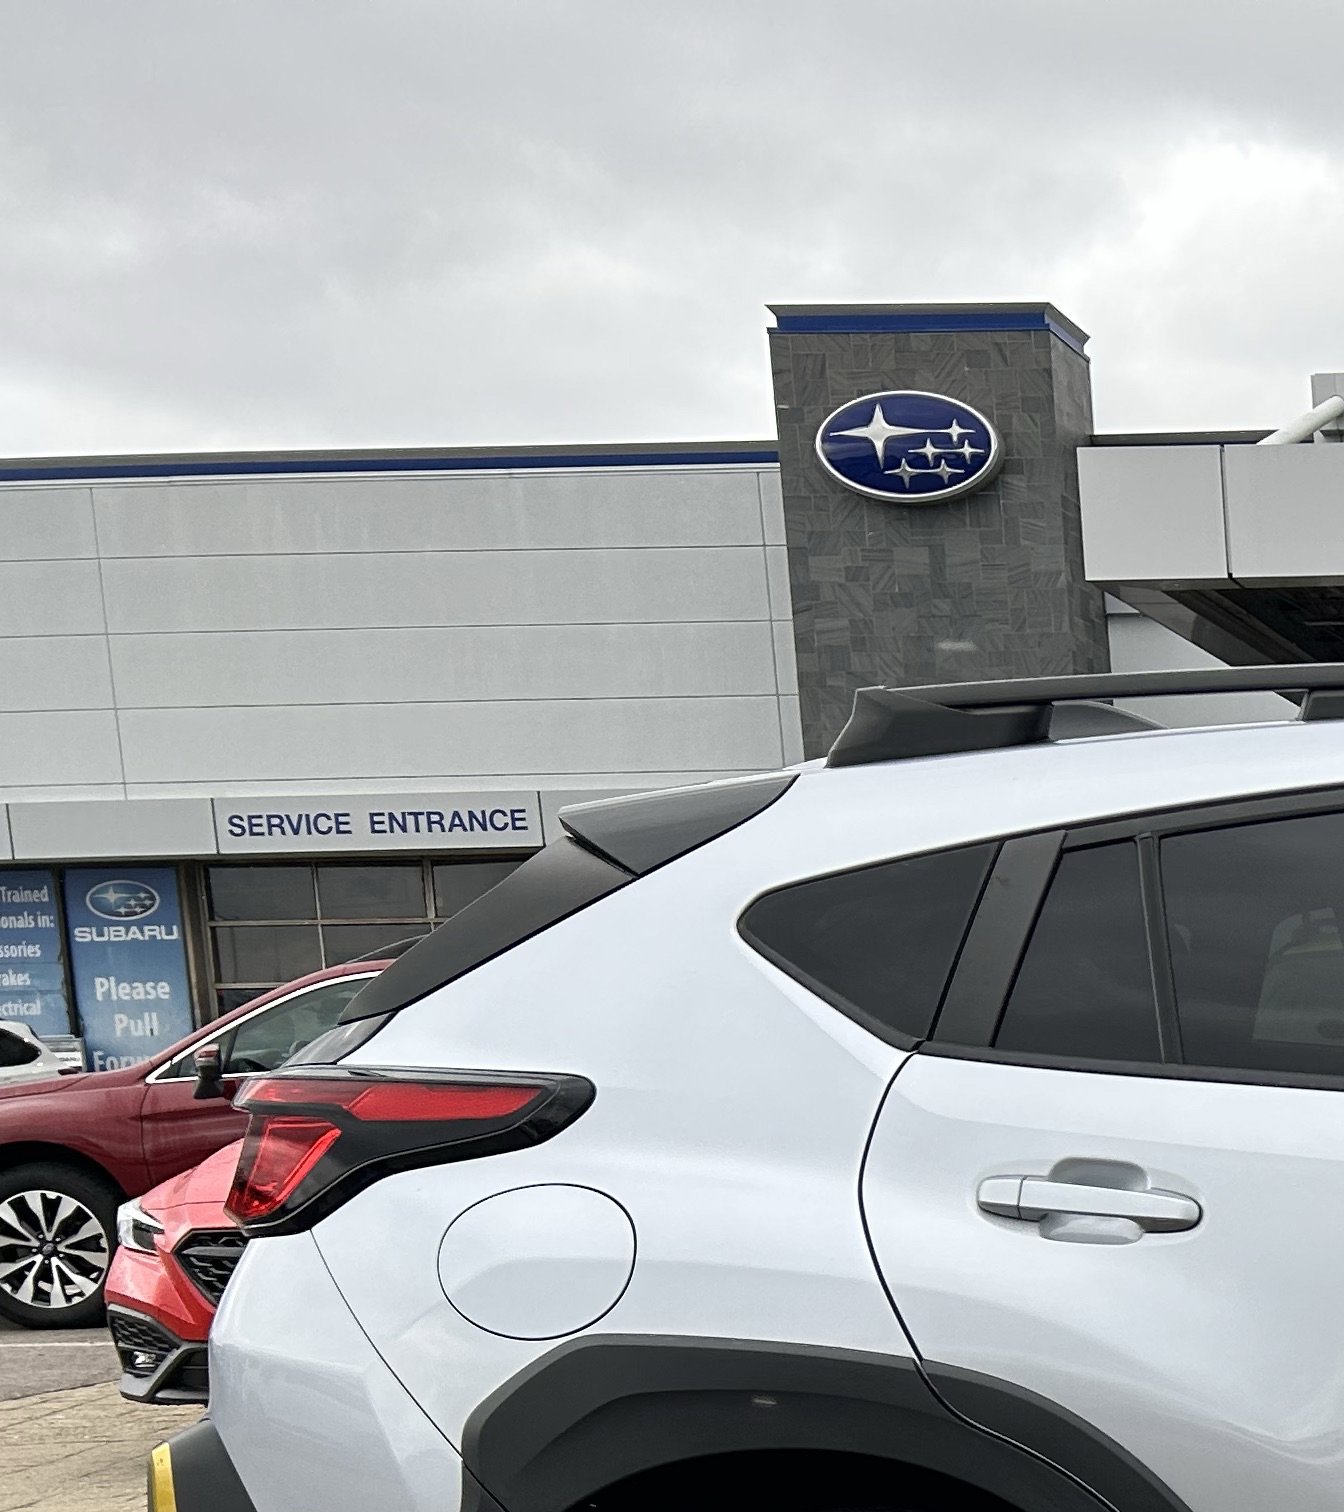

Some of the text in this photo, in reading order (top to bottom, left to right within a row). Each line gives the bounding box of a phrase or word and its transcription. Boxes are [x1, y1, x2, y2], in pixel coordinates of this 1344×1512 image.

[227, 808, 529, 837] SERVICE ENTRANCE
[37, 911, 55, 928] in:
[74, 925, 179, 942] SUBARU
[94, 976, 170, 1001] Please
[114, 1012, 159, 1037] Pull
